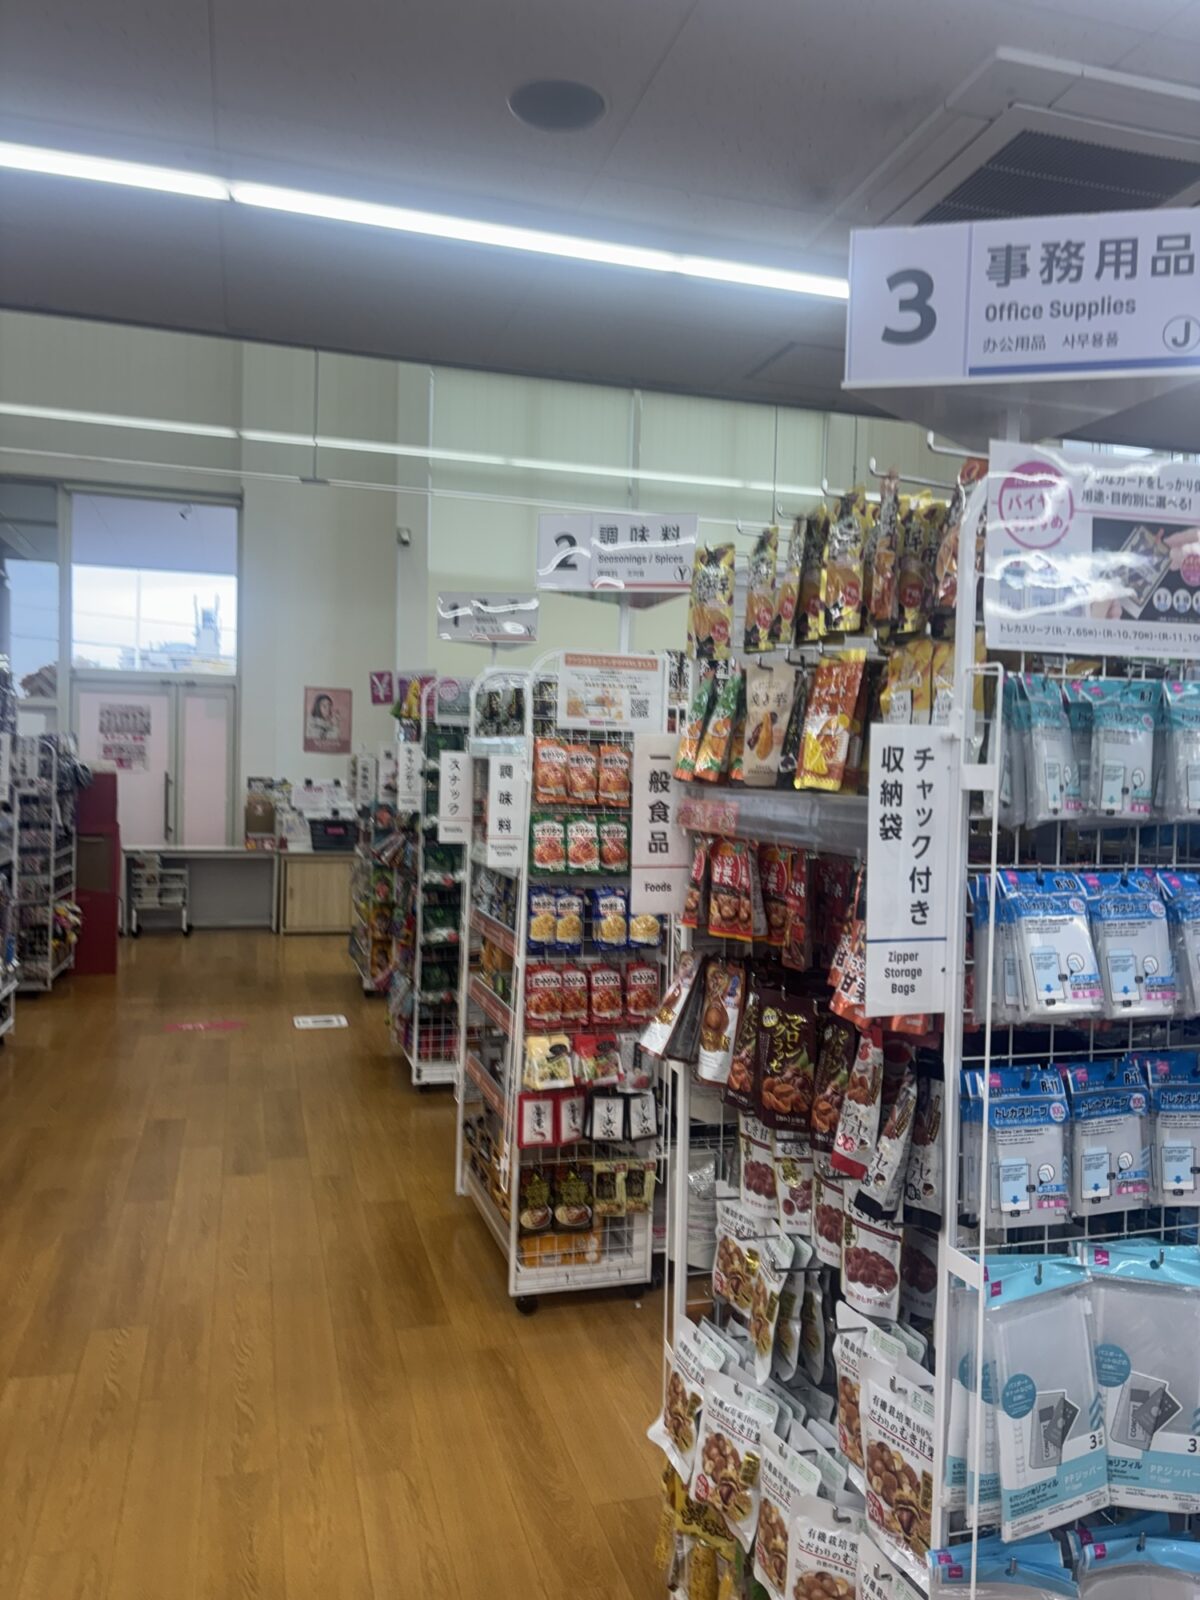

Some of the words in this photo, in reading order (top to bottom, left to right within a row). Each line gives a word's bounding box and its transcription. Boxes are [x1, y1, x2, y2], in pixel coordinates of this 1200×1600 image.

[985, 233, 1196, 287] 事務用品
[881, 268, 938, 346] 3
[985, 300, 1043, 322] Office
[1049, 295, 1136, 321] Supplies
[983, 336, 1046, 353] 办公用品
[1171, 319, 1191, 348] J
[599, 524, 681, 545] 調味料
[554, 533, 579, 571] 2
[655, 554, 684, 564] Spices
[448, 758, 462, 816] スナック
[498, 764, 514, 833] 調味料
[879, 746, 904, 841] 収納袋
[648, 755, 671, 854] 一般食品
[909, 747, 934, 925] チャック付き
[644, 882, 672, 893] Foods
[884, 967, 923, 980] Storage
[888, 952, 919, 968] Zipper
[891, 983, 916, 996] Bags
[1089, 1434, 1097, 1450] 3
[1188, 1438, 1197, 1453] 3
